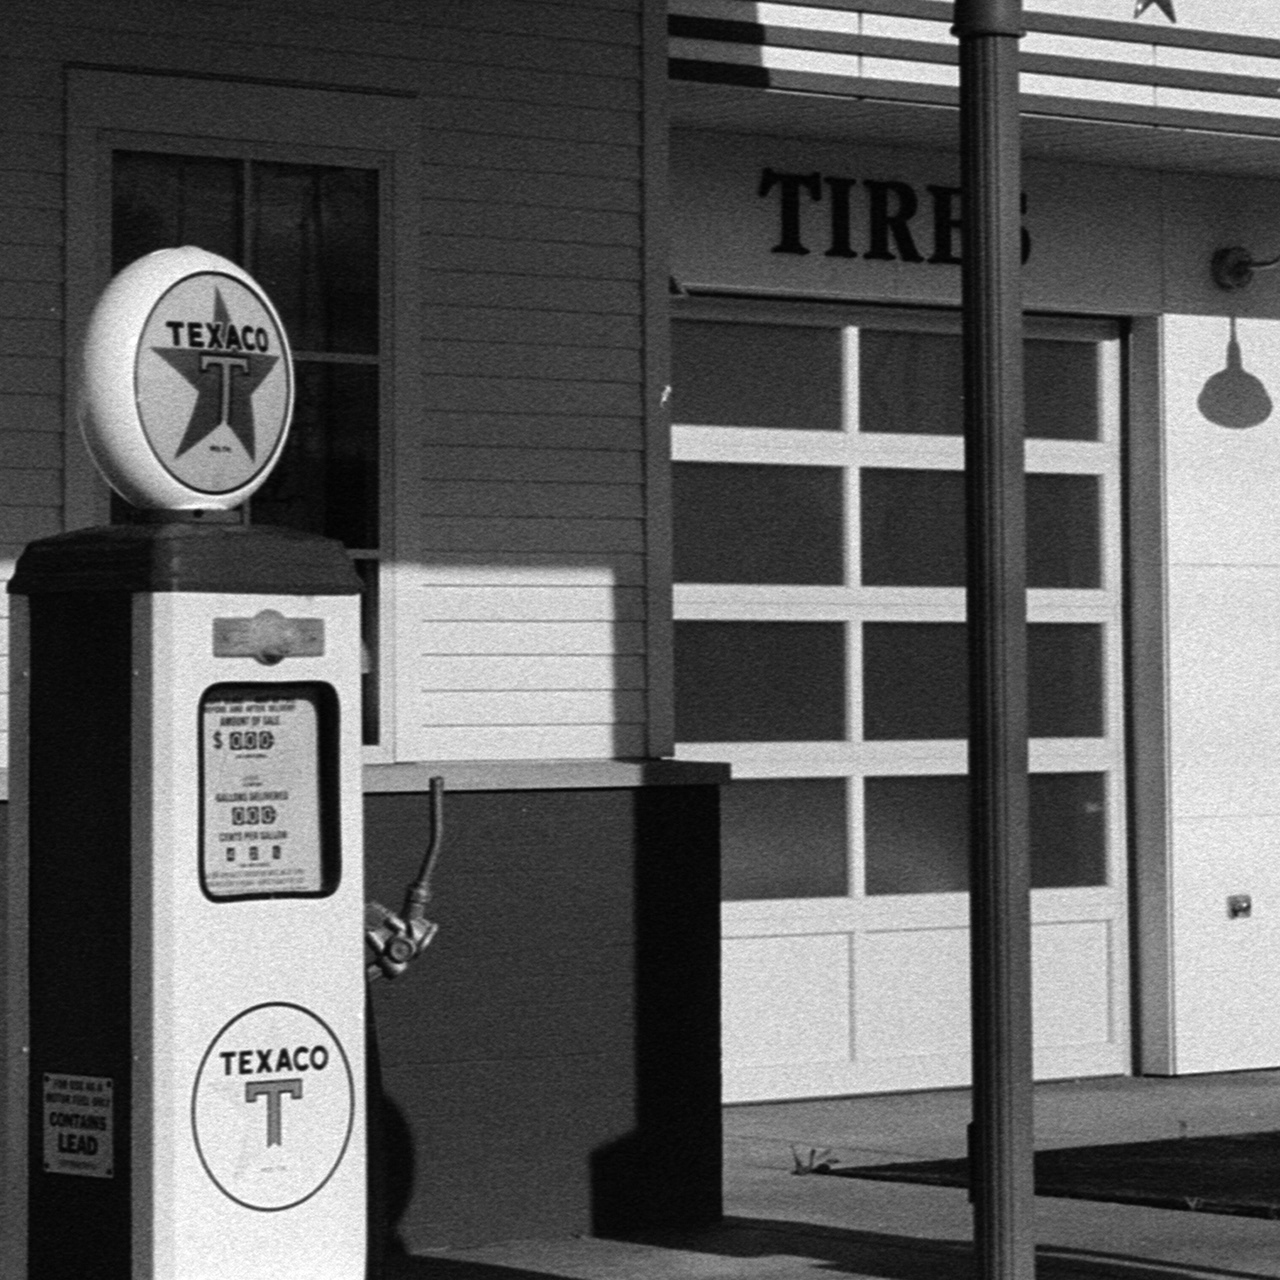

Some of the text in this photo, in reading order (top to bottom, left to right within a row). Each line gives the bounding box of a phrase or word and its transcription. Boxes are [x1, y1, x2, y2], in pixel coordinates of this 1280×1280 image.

[757, 168, 1030, 268] TIRE
[165, 320, 269, 352] TEXACO
[219, 1045, 329, 1076] TEXACO
[49, 1111, 107, 1131] CONTAINS
[245, 1078, 303, 1148] T
[58, 1132, 98, 1156] LEAD
